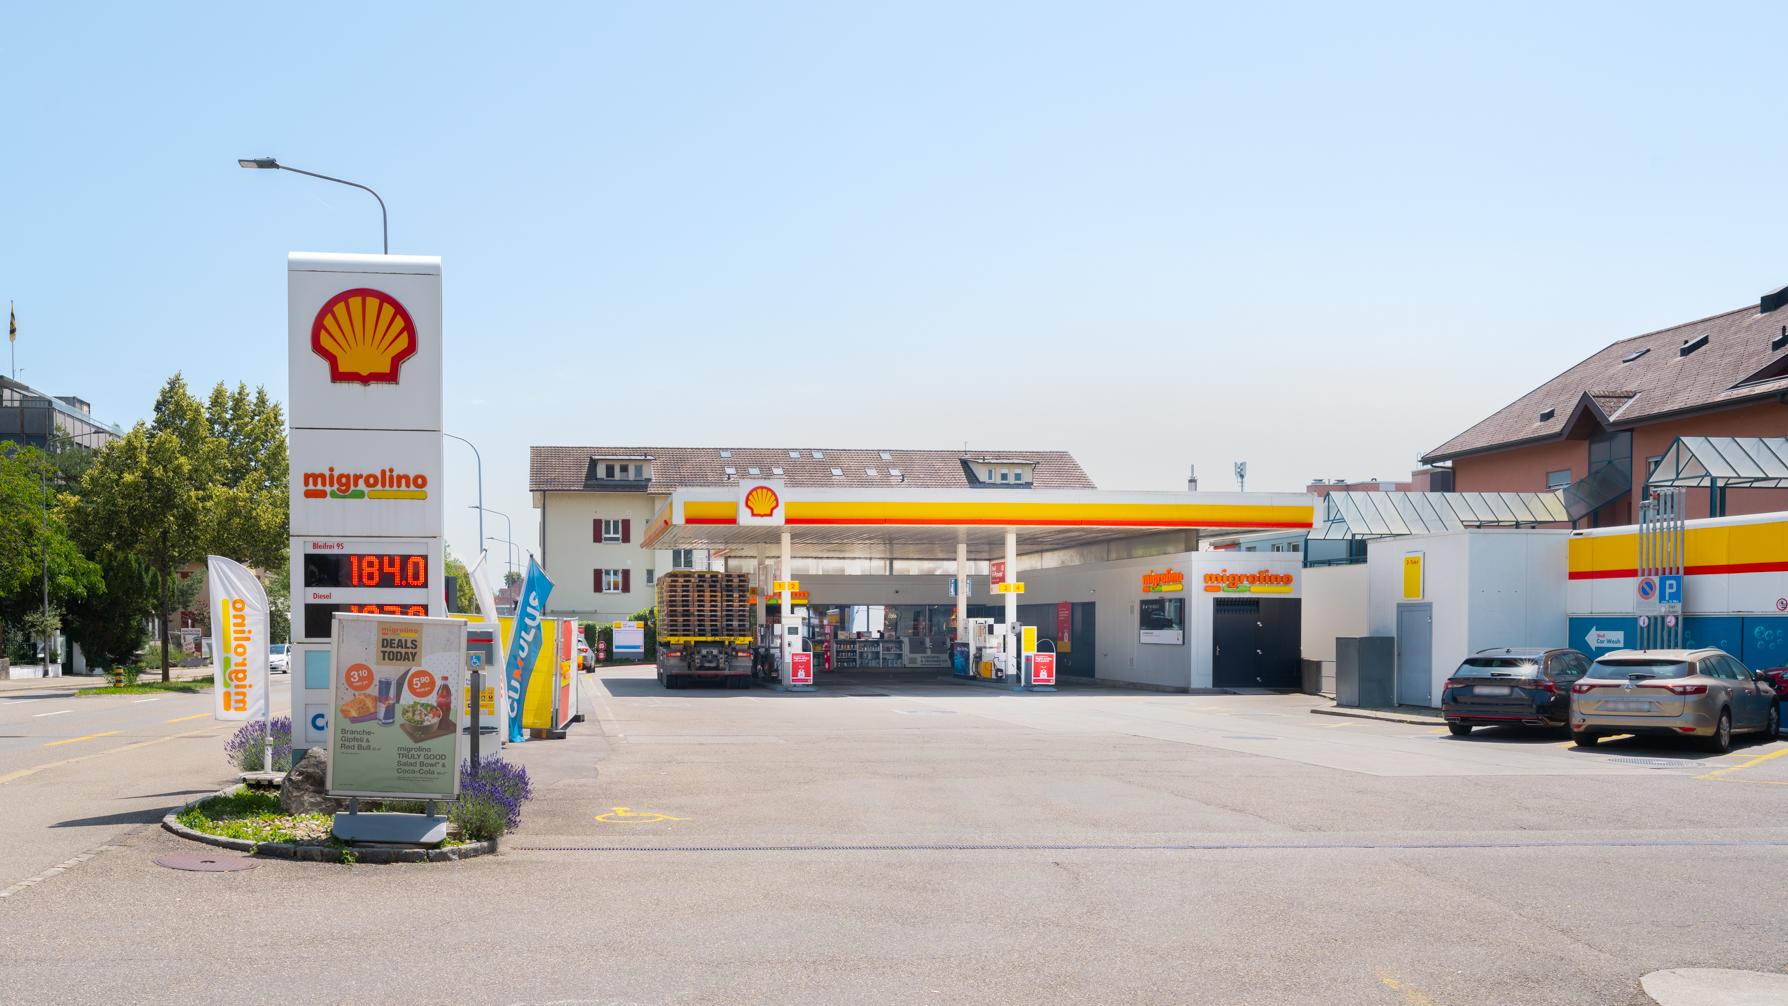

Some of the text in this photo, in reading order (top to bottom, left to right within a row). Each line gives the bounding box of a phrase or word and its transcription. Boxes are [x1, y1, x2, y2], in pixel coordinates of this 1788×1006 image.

[303, 466, 428, 494] migrolino
[312, 542, 344, 550] Bleifrei 95
[350, 555, 425, 586] 184.0
[1142, 568, 1184, 588] migrolino
[1203, 568, 1294, 588] migrolino
[312, 592, 332, 600] Diesel
[1665, 580, 1677, 600] P
[381, 638, 418, 650] DEALS
[380, 650, 417, 662] TODAY
[311, 713, 328, 731] C
[340, 728, 375, 736] Branche-
[340, 735, 364, 744] Gipfeli
[340, 743, 355, 751] Red
[357, 743, 371, 751] Bull
